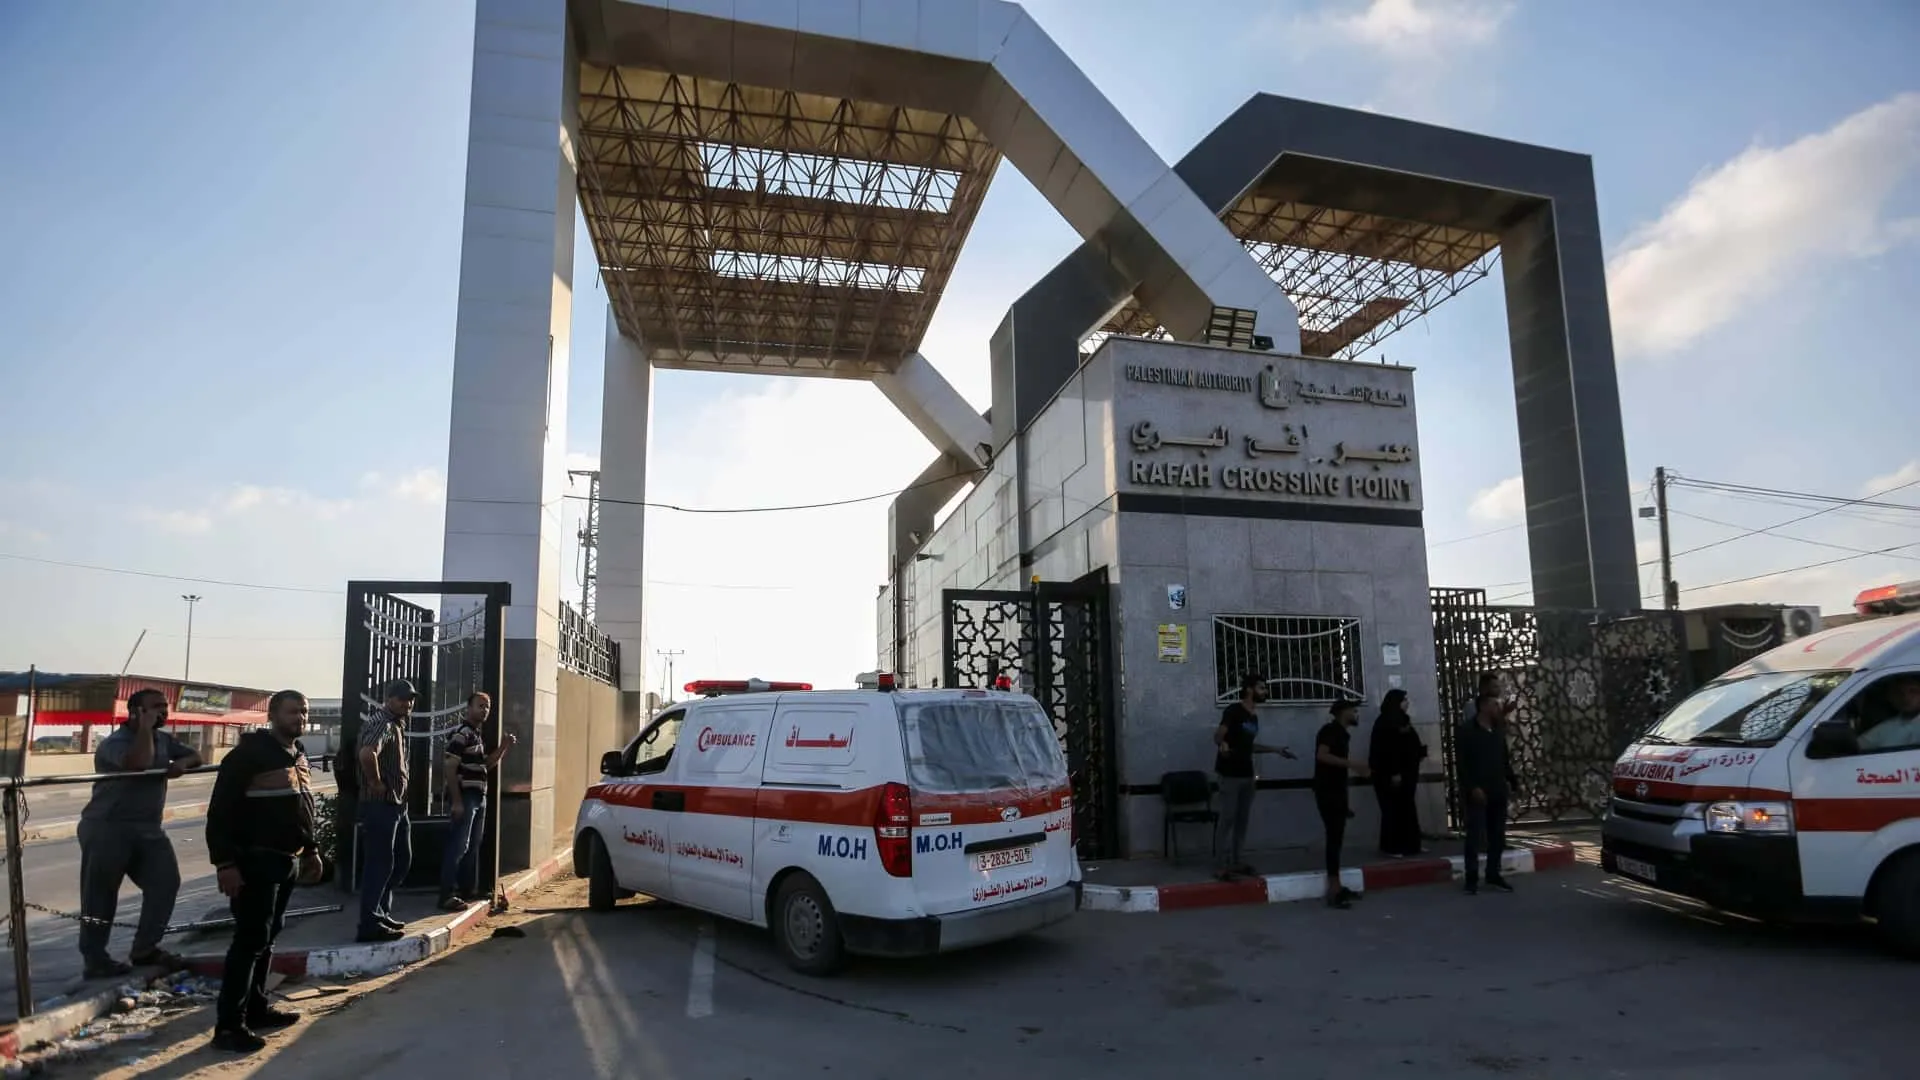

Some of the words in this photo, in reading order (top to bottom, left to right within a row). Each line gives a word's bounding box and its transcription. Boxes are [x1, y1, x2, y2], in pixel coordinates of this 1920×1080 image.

[1126, 365, 1194, 387] PALESTINIAN
[1197, 371, 1254, 393] AUTHORITY
[1129, 420, 1230, 458] البري
[1328, 441, 1412, 472] معبر
[1130, 460, 1213, 488] RAFAH
[1221, 464, 1341, 496] CROSSING
[1349, 475, 1414, 501] POINT
[1719, 751, 1756, 767] وزارة
[818, 834, 868, 861] M.O.H
[915, 831, 963, 854] M.O.H
